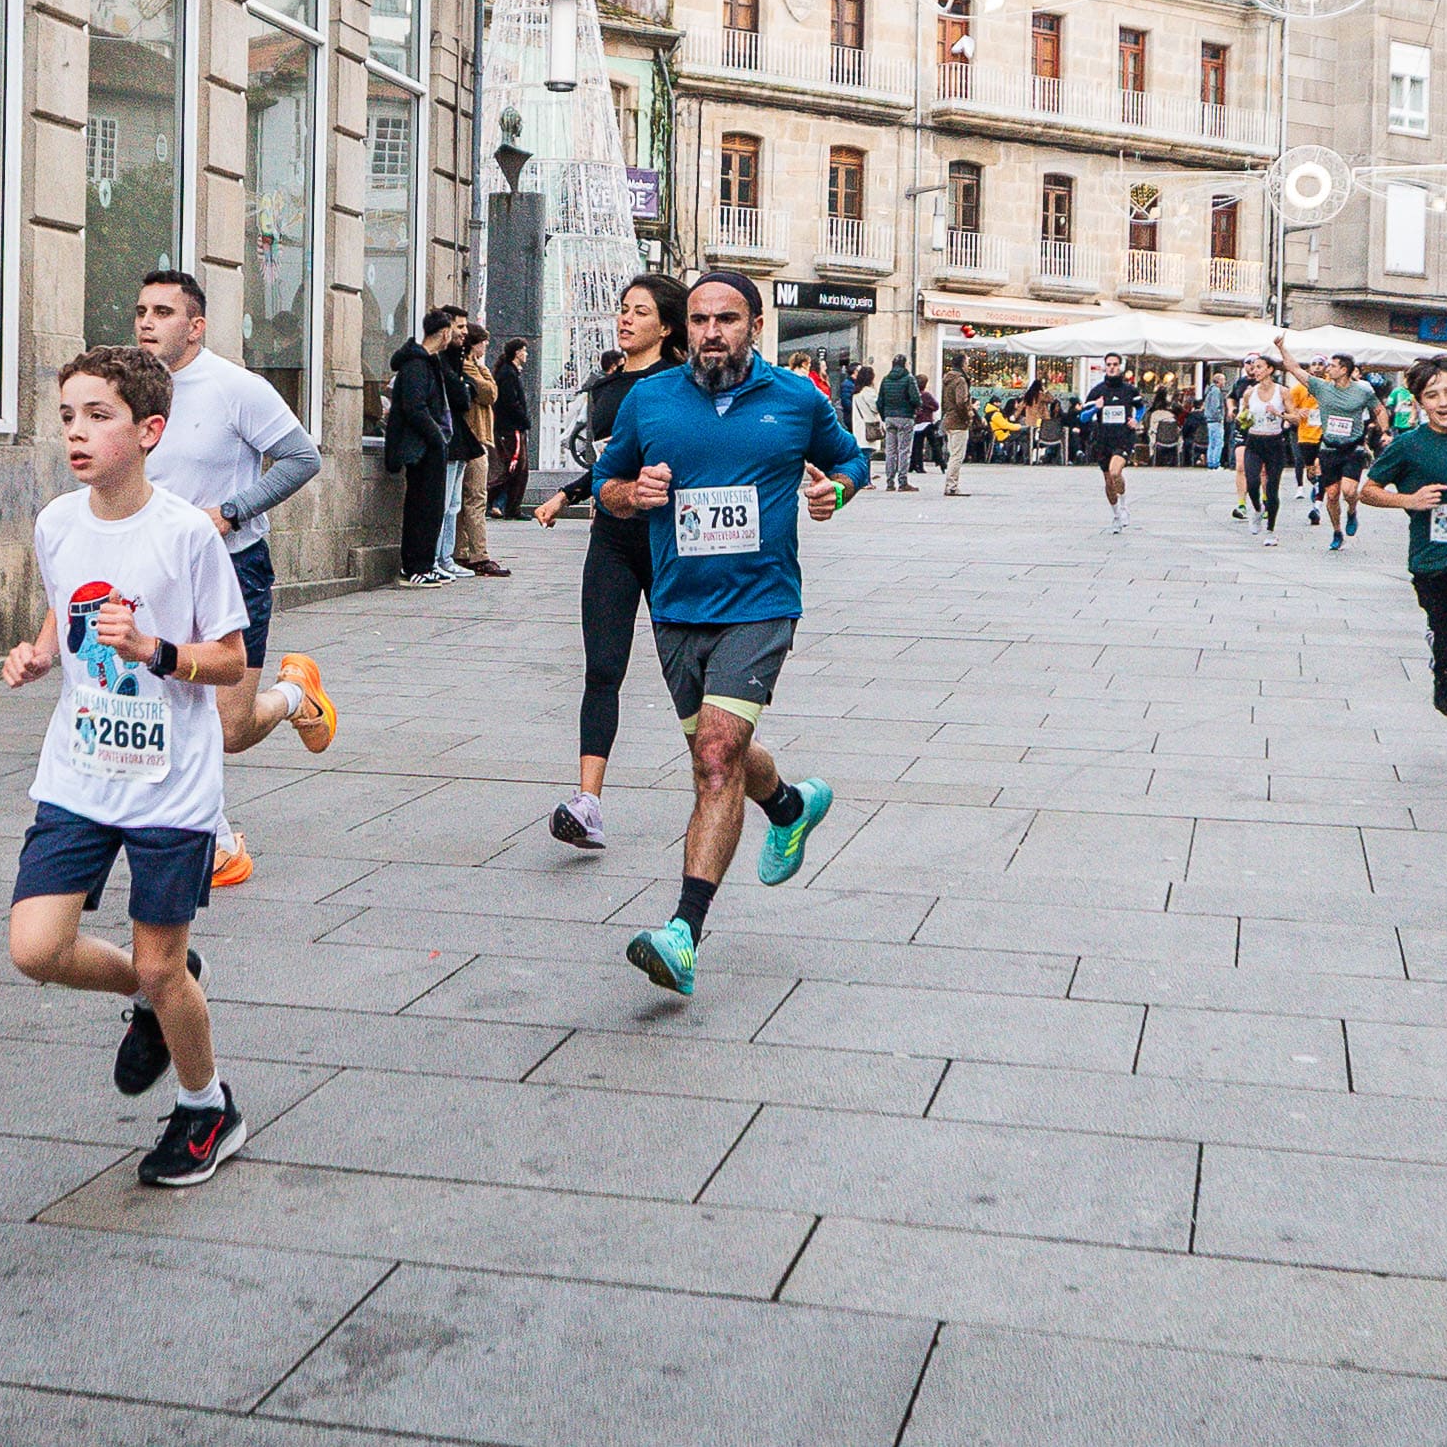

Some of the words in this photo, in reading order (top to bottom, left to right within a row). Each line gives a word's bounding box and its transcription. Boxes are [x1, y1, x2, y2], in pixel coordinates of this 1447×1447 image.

[840, 295, 873, 310] Nogueira
[692, 491, 709, 505] SAN
[711, 489, 754, 504] SILVESTRE
[709, 505, 747, 529] 783
[703, 530, 740, 541] PONTEVEDRA
[741, 529, 756, 539] 2025
[91, 694, 108, 714] SAN
[111, 699, 164, 720] SILVESTRE
[99, 716, 165, 751] 2664
[98, 749, 143, 764] PONTEVEDRA
[146, 753, 165, 766] 2025
